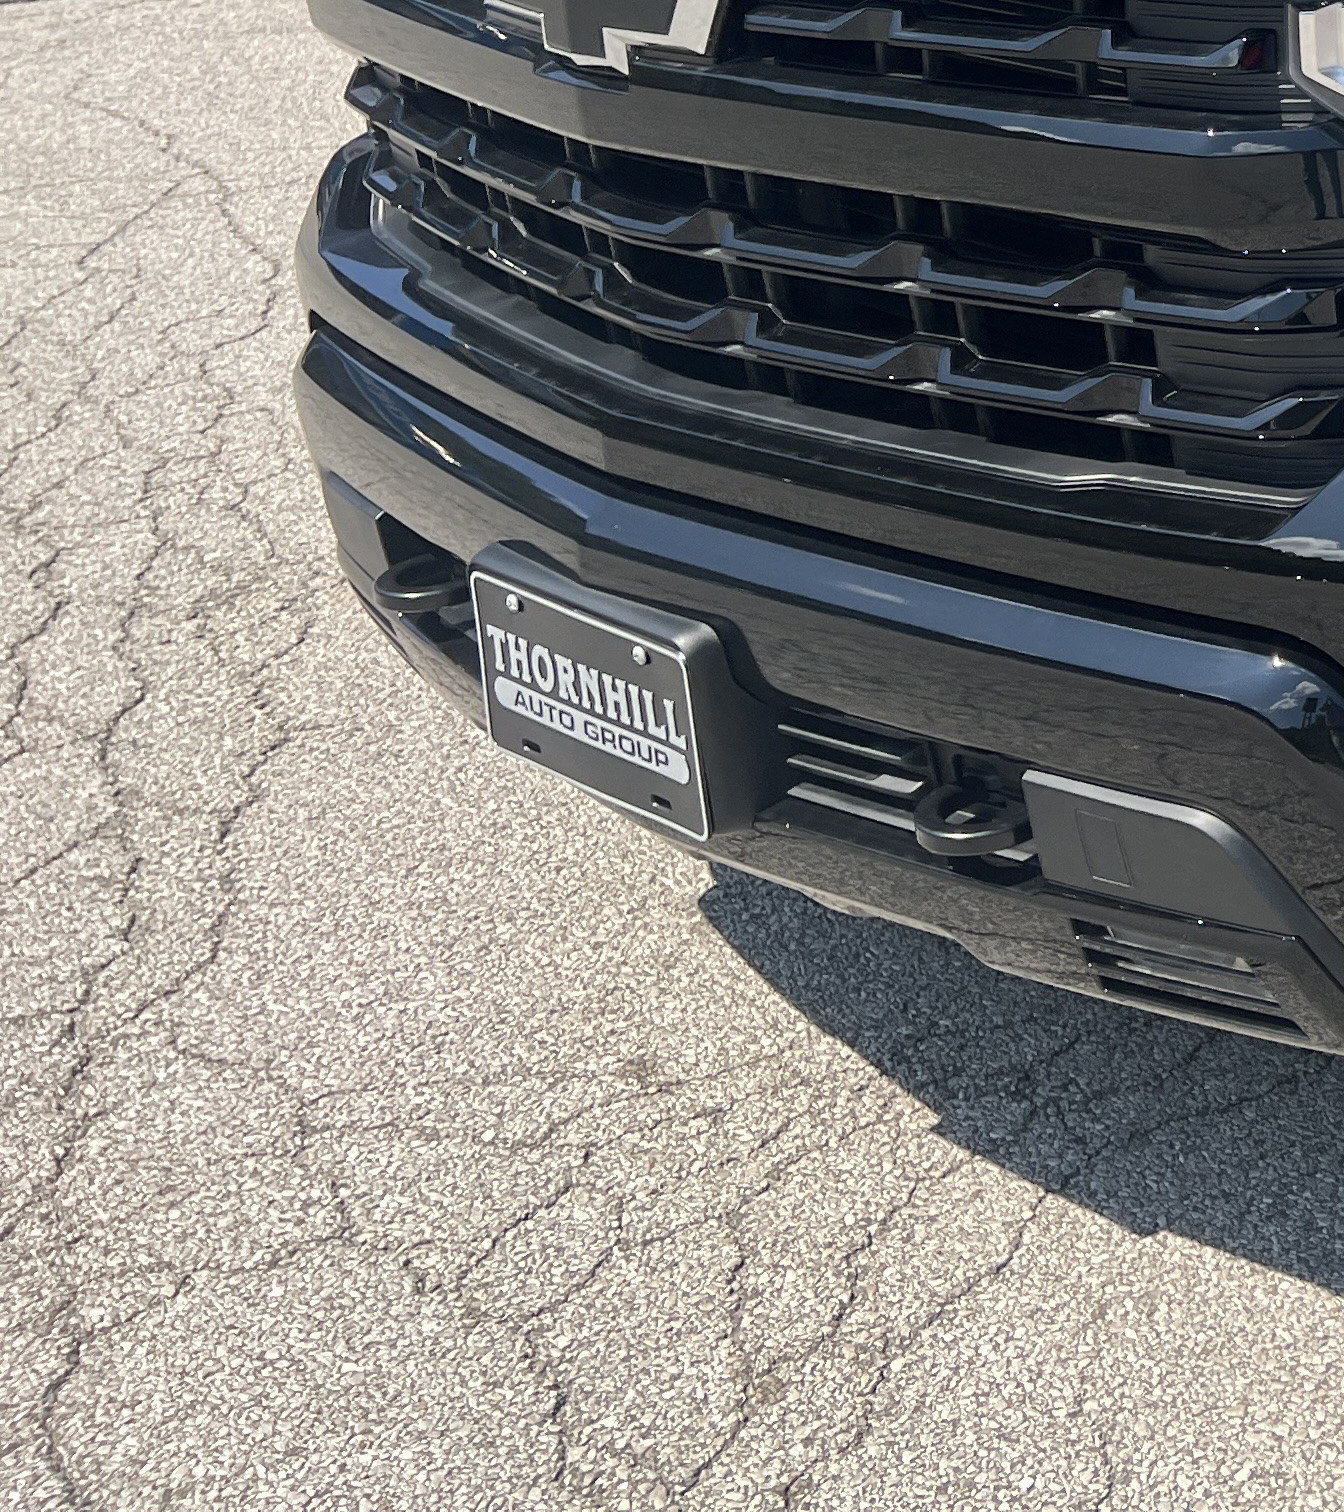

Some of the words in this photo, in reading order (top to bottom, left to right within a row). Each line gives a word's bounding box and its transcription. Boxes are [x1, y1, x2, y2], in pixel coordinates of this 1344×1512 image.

[487, 624, 687, 750] THORNHILL
[513, 690, 575, 733] AUTO
[583, 721, 670, 770] GROUP
